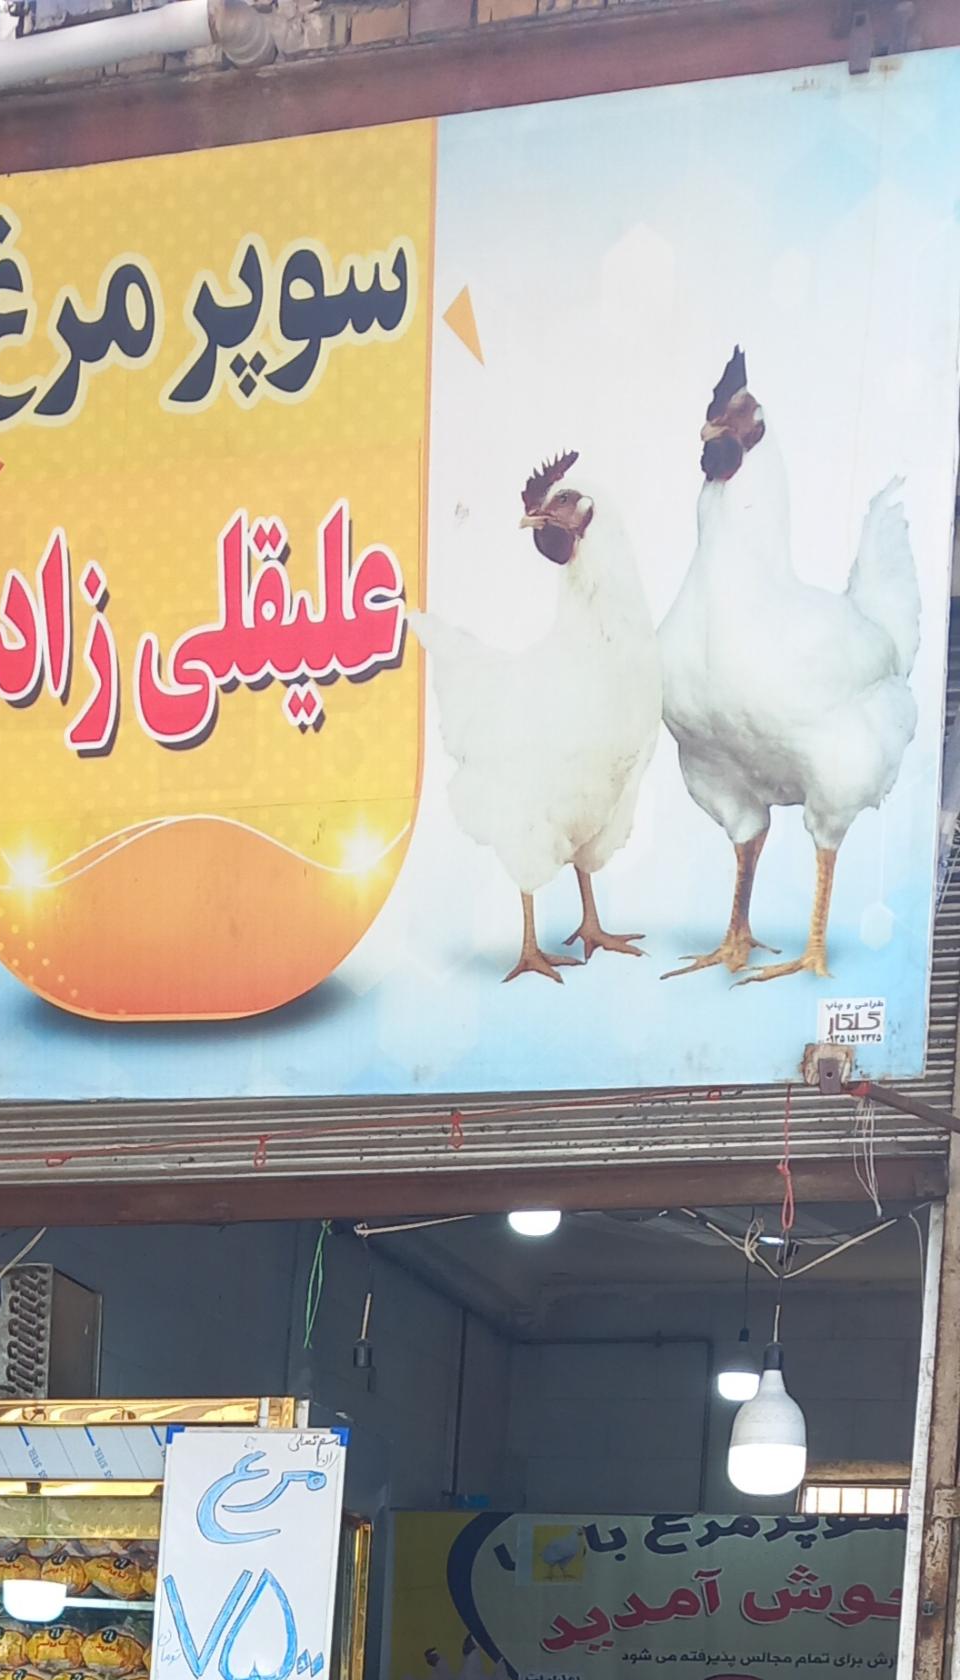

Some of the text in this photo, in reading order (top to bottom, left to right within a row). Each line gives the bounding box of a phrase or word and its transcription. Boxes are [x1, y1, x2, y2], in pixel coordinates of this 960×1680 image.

[167, 243, 409, 401] سوپر
[141, 502, 405, 744] علیقلی
[196, 1437, 327, 1544] مرغ
[542, 1567, 724, 1653] آمدید
[621, 1648, 652, 1665] شود
[655, 1652, 677, 1665] می
[679, 1649, 737, 1667] پذیرفته
[740, 1651, 792, 1667] مجالس
[794, 1651, 829, 1668] تمام
[832, 1652, 863, 1668] برای
